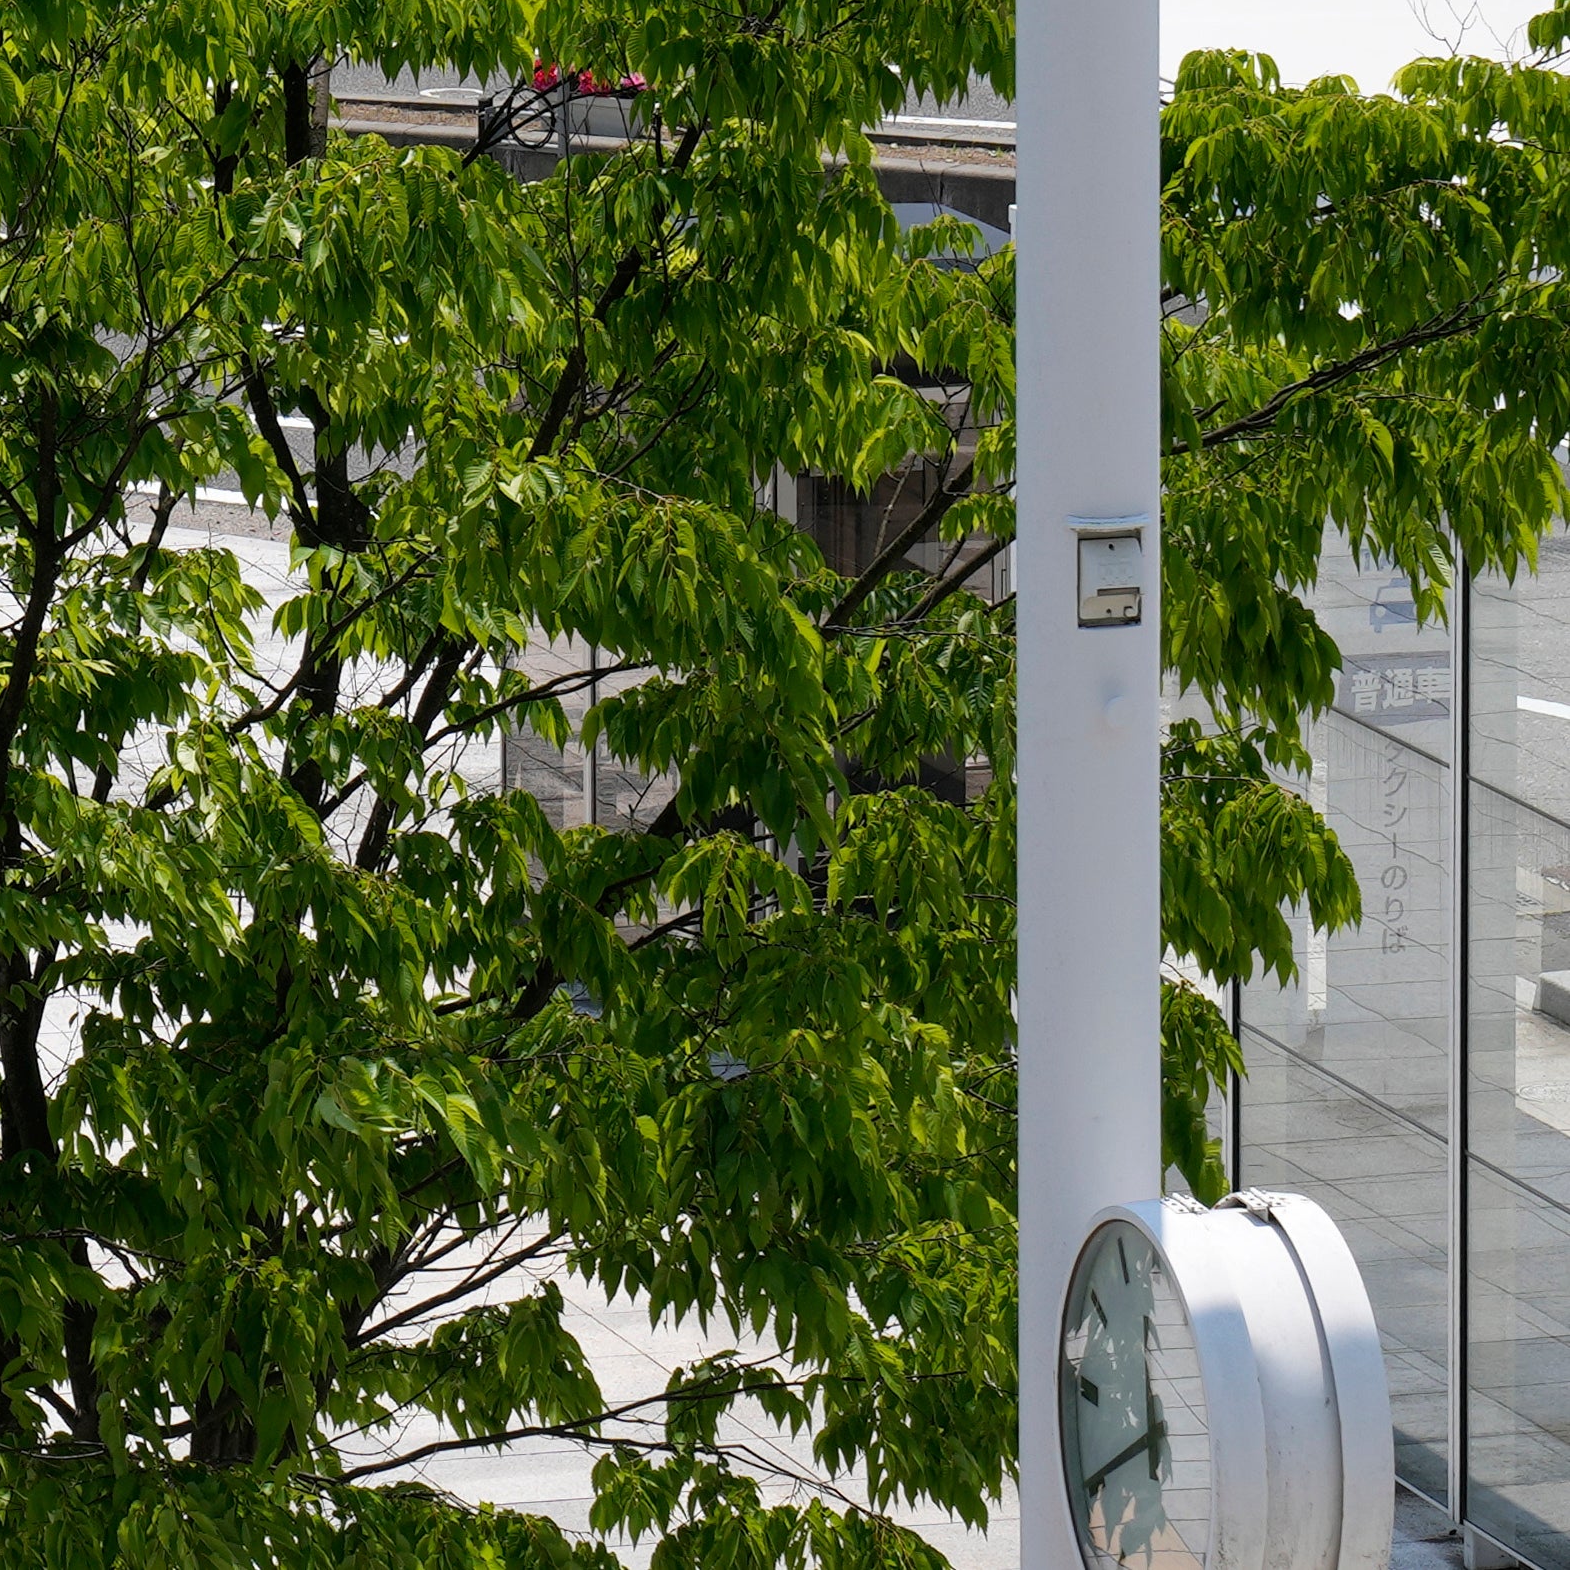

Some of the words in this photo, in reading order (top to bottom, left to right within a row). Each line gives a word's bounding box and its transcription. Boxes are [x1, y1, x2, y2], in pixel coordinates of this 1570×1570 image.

[1351, 668, 1451, 713] 普通車
[1381, 739, 1408, 955] タクシーのりば
